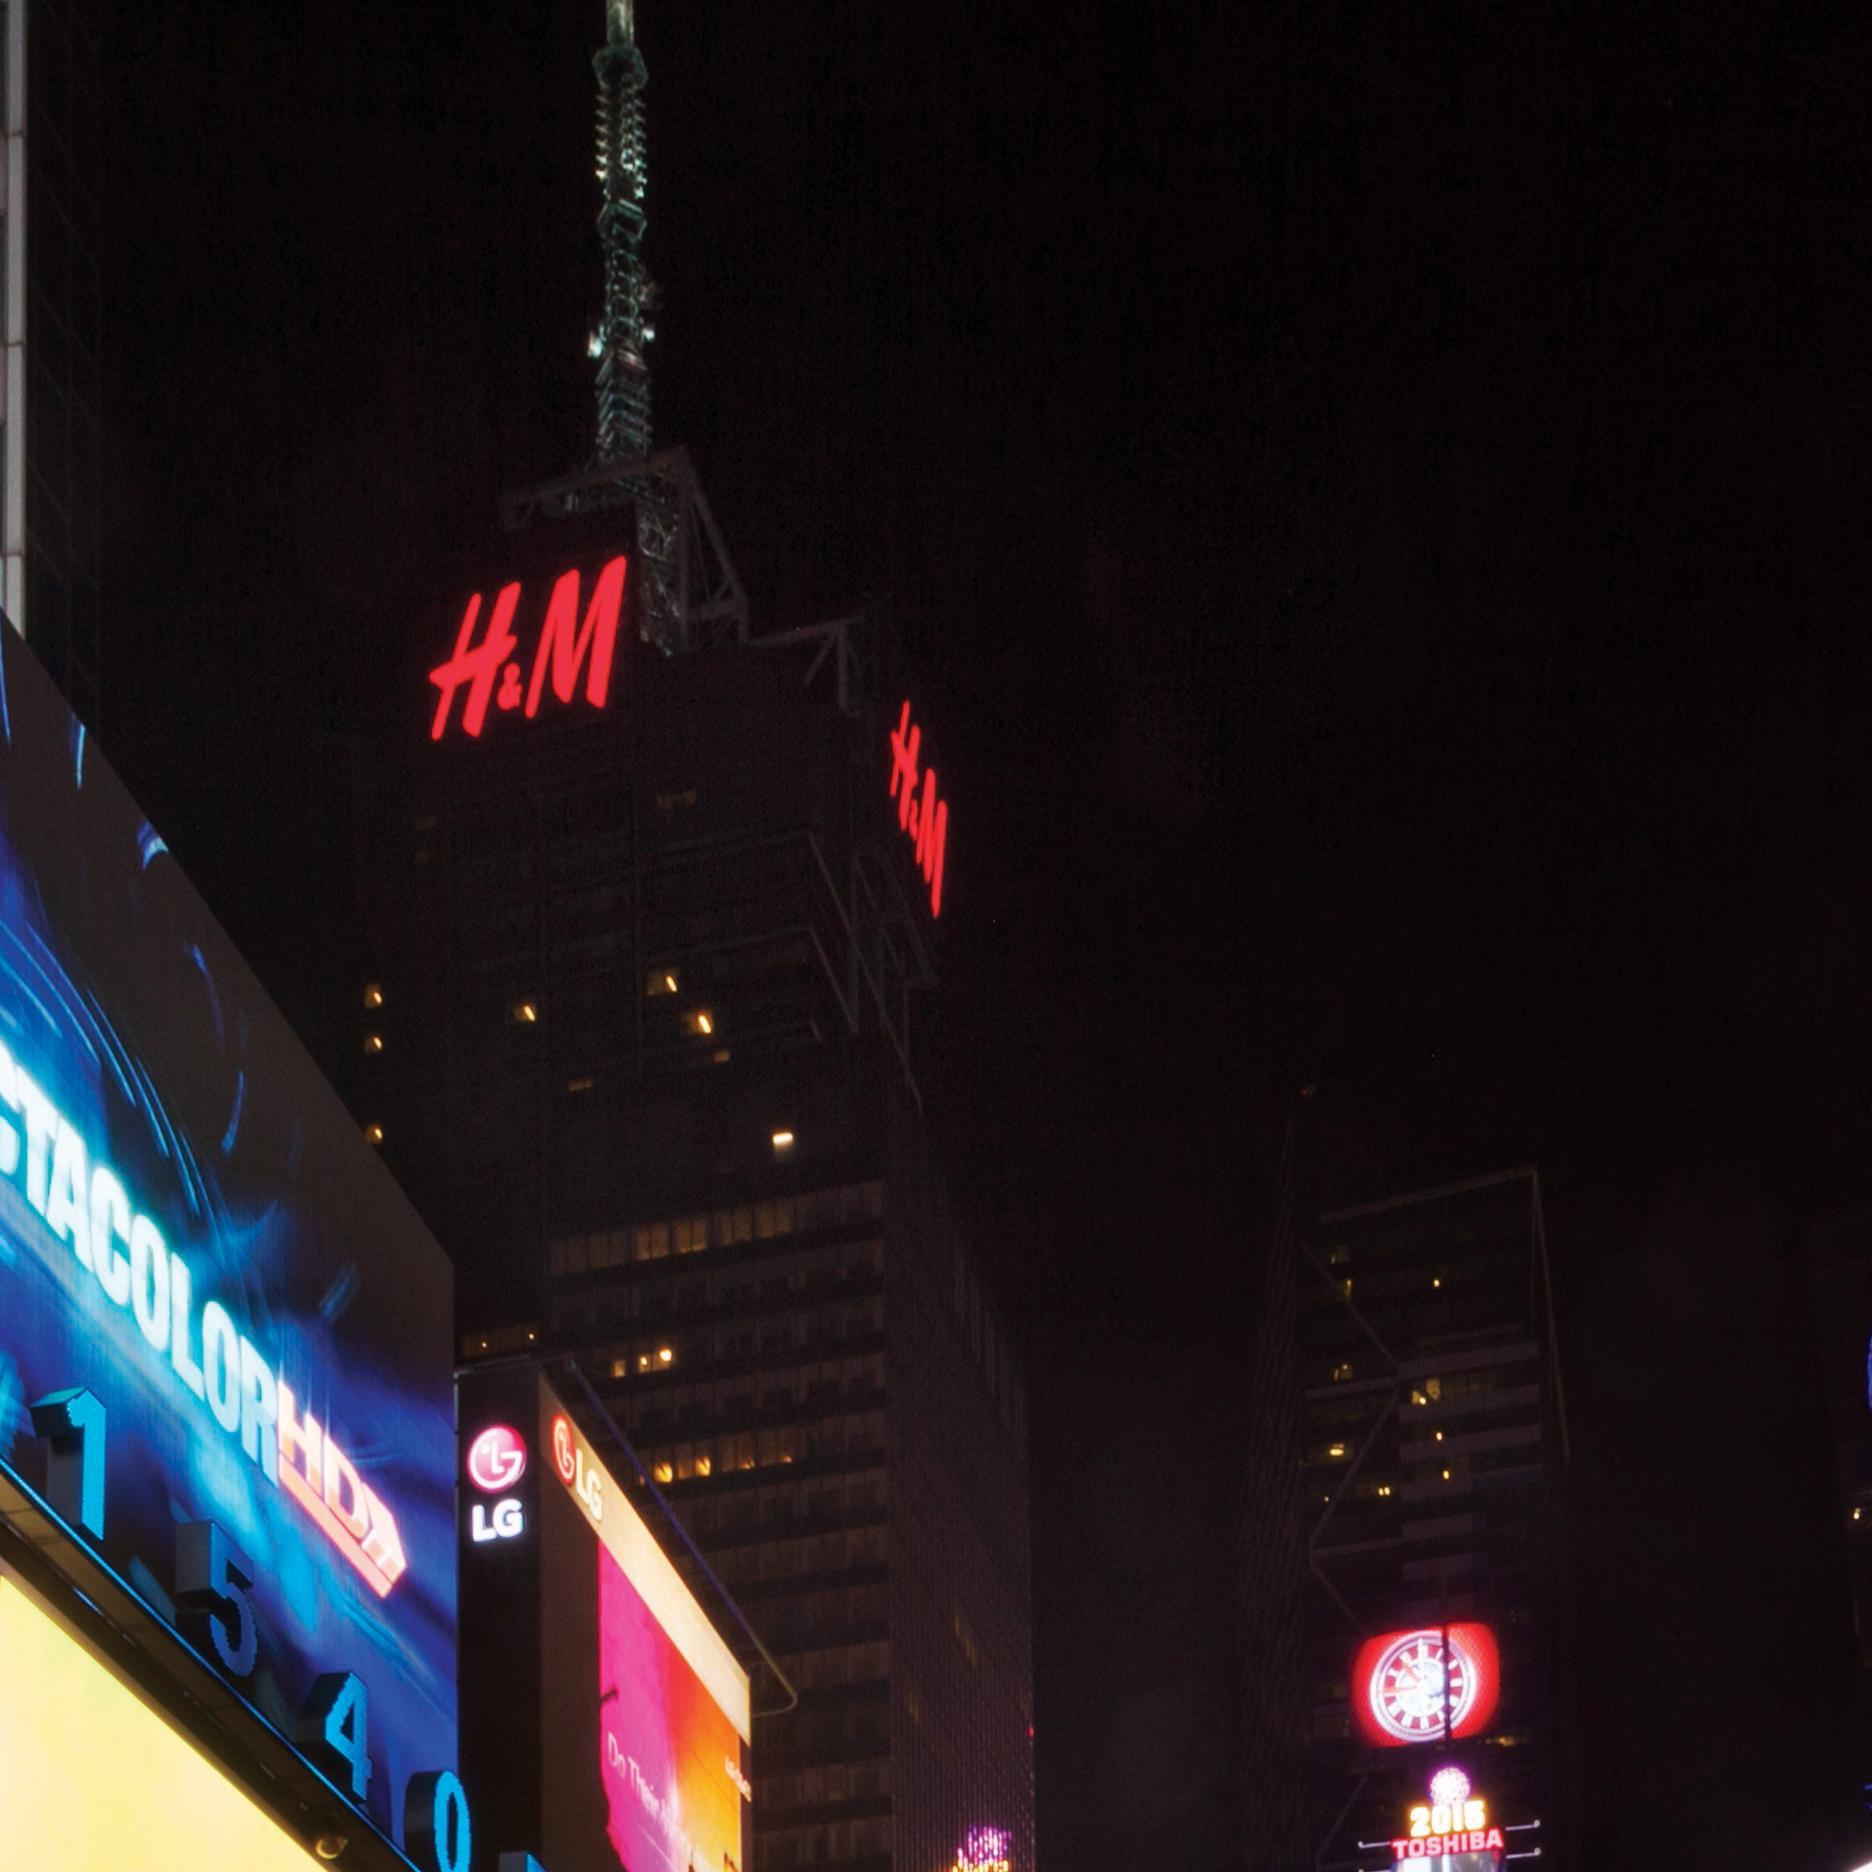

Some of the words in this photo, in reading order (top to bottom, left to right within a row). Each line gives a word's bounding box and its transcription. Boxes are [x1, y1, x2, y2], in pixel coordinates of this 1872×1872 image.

[429, 556, 626, 740] H&M
[890, 700, 947, 918] H&M
[574, 1461, 603, 1522] LG
[471, 1500, 523, 1544] LG
[1410, 1799, 1485, 1836] 2015
[1392, 1829, 1504, 1859] TOSHIBA
